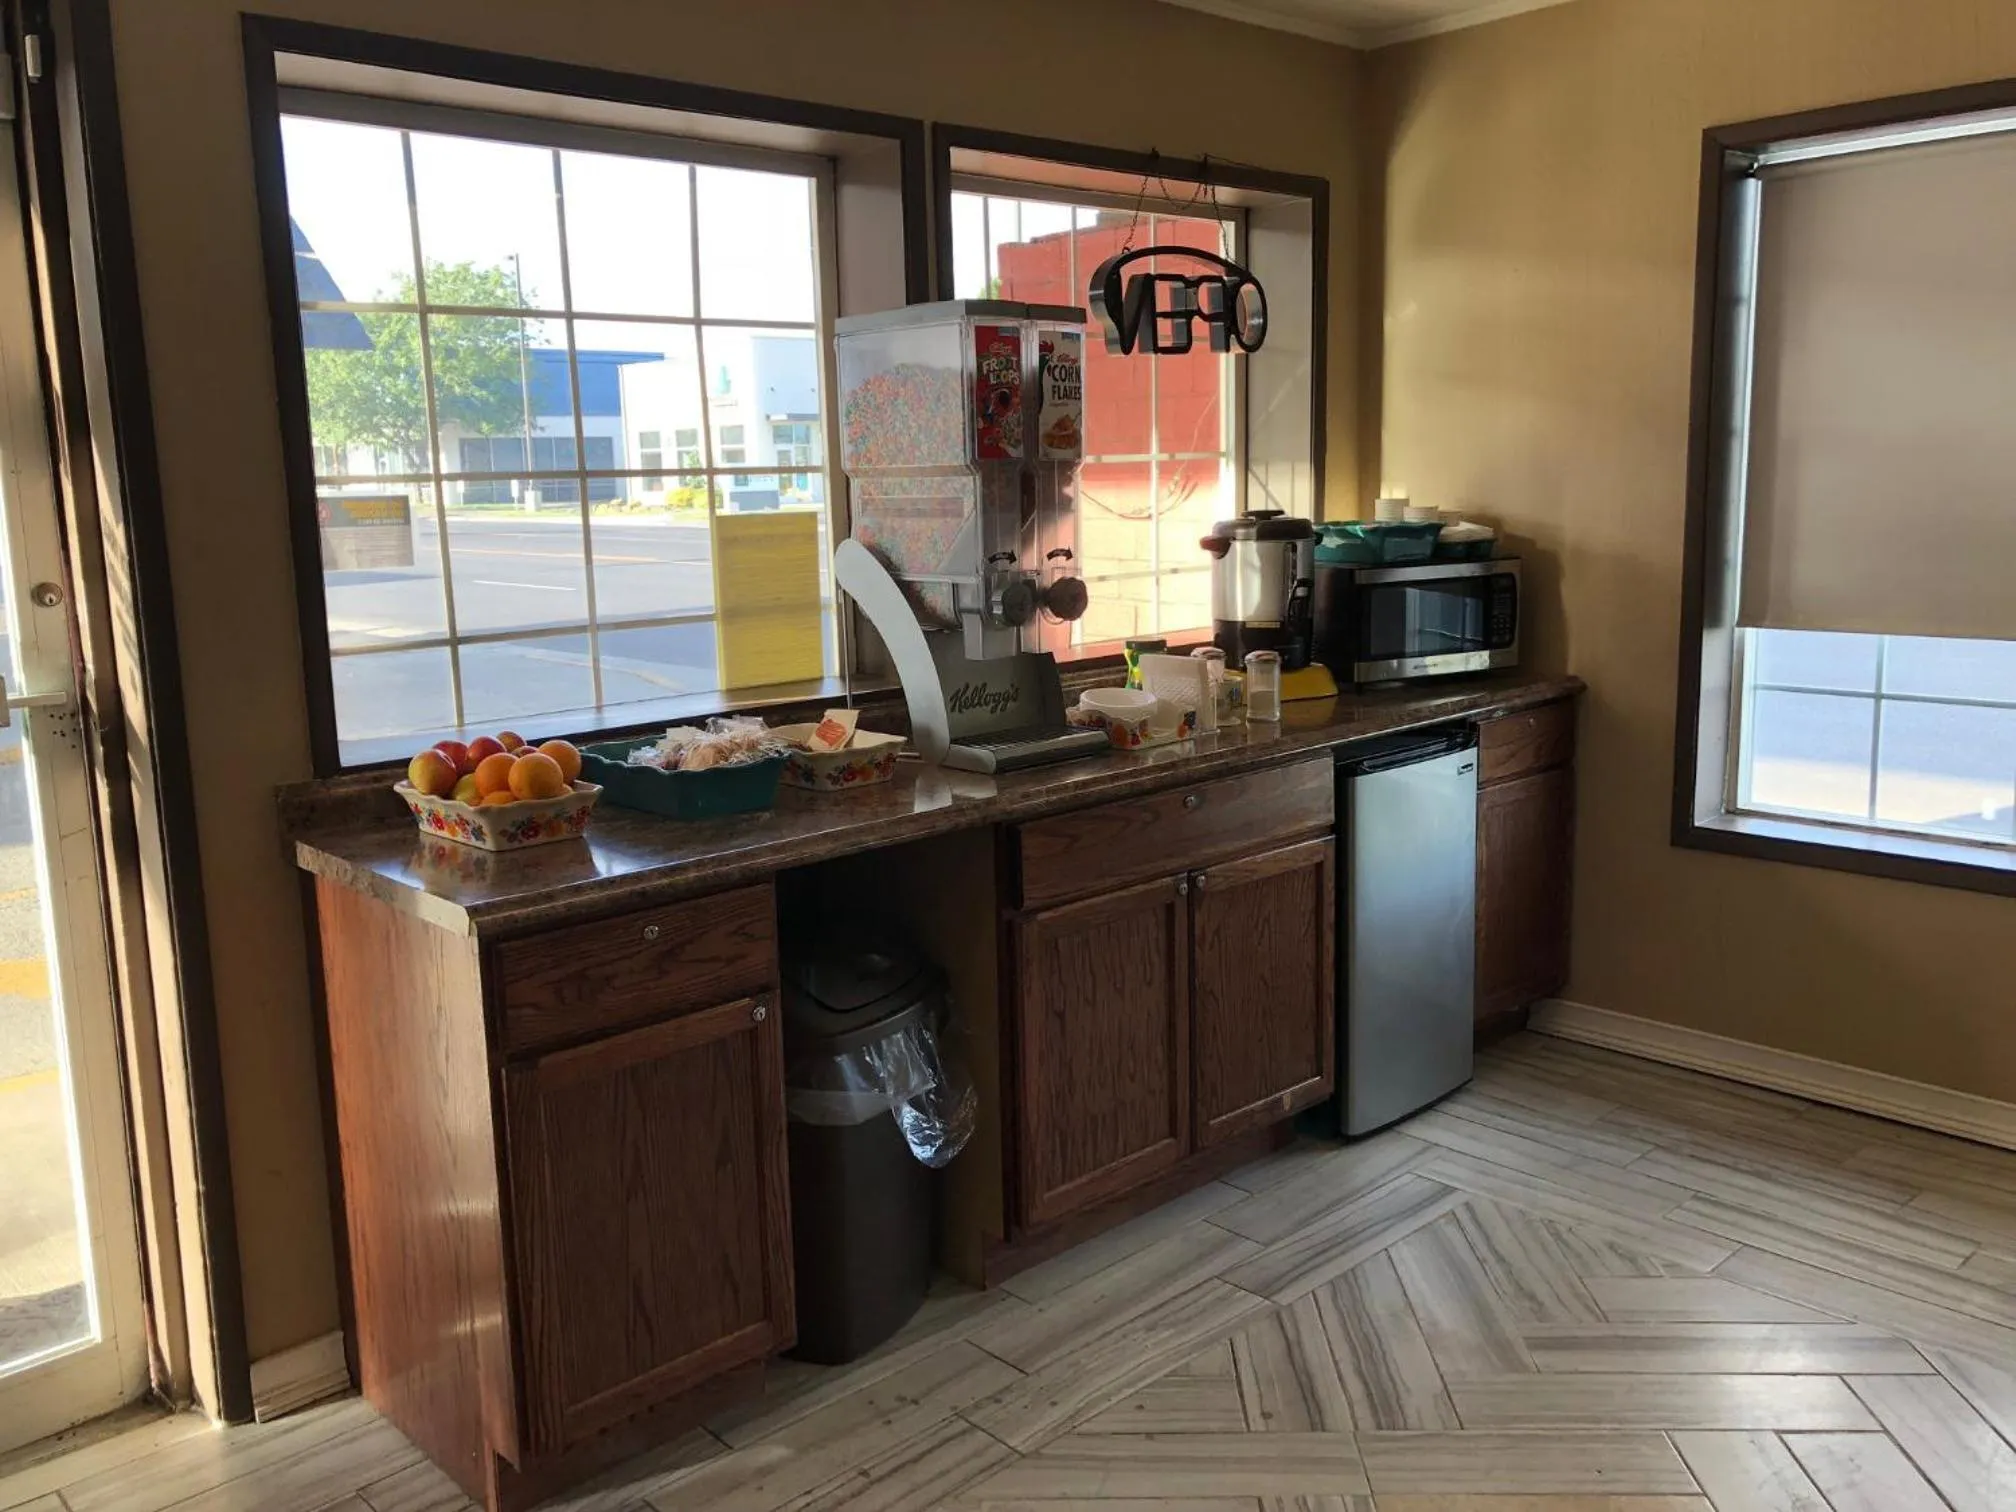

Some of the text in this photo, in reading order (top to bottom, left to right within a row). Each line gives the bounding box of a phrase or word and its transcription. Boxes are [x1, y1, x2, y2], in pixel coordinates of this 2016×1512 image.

[1052, 364, 1081, 382] CORN
[1052, 385, 1081, 401] FLAKES
[950, 682, 1020, 713] Kellogg's
